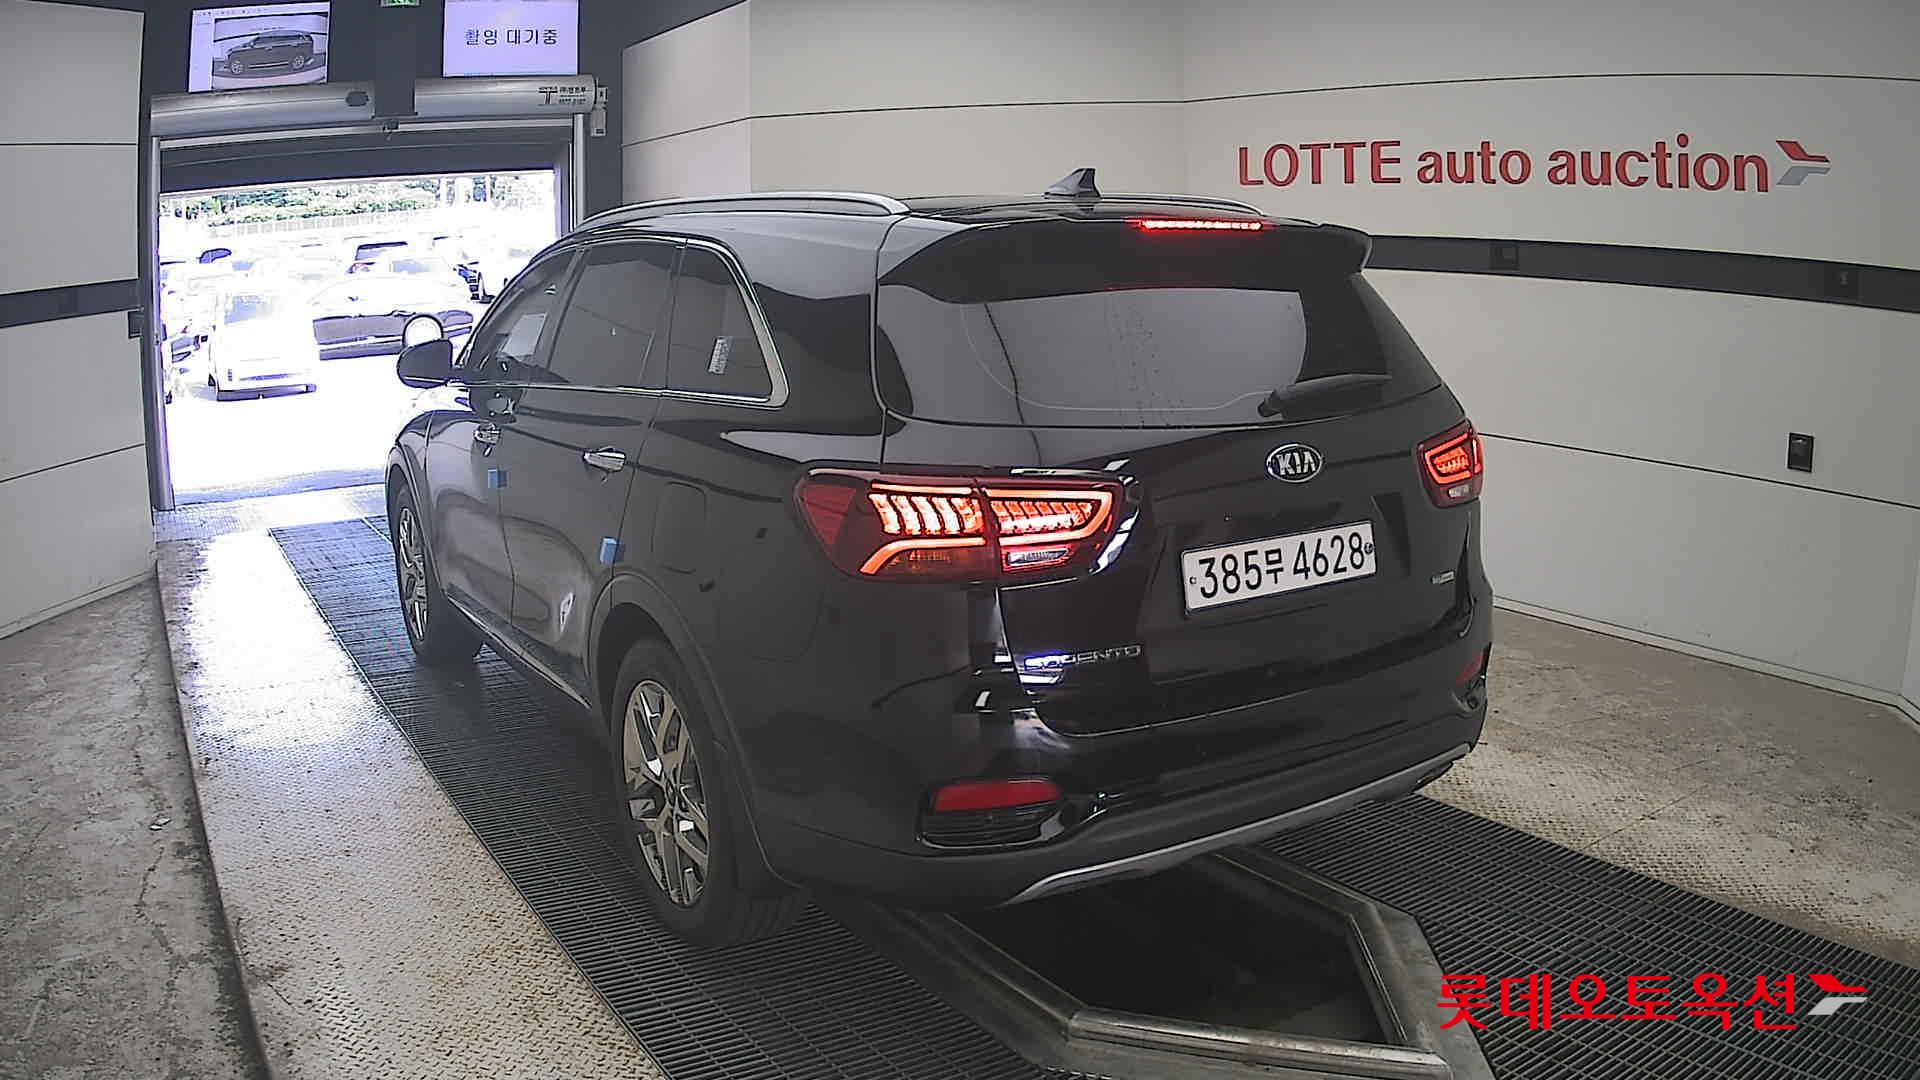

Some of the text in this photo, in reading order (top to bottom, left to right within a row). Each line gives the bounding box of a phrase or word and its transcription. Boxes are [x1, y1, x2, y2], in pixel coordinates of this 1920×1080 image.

[1239, 133, 1769, 193] LOTTE auto auction
[1276, 451, 1316, 475] KIA
[1198, 532, 1365, 599] 385무 4628
